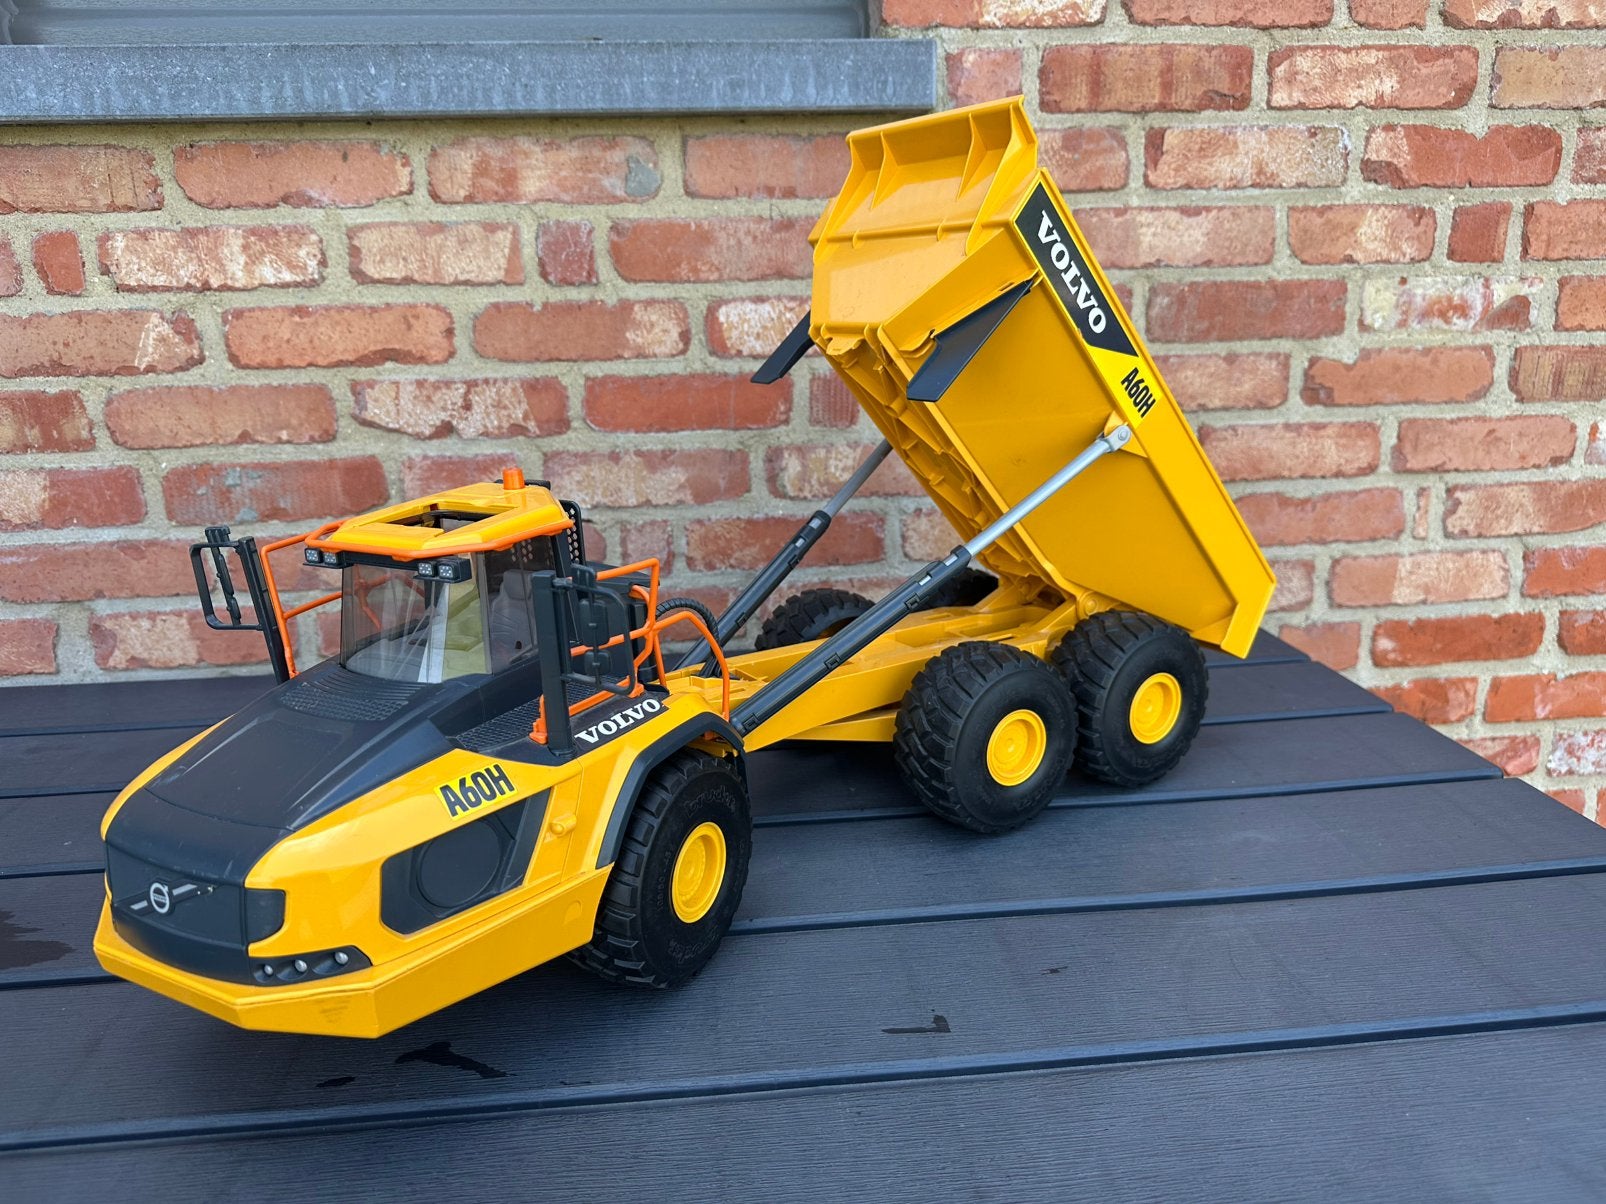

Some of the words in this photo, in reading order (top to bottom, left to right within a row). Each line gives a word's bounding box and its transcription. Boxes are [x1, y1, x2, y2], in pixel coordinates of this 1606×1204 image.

[1037, 210, 1107, 334] VOLVO
[1120, 367, 1156, 418] A60H
[574, 698, 661, 744] VOLVO
[439, 763, 515, 817] A60H
